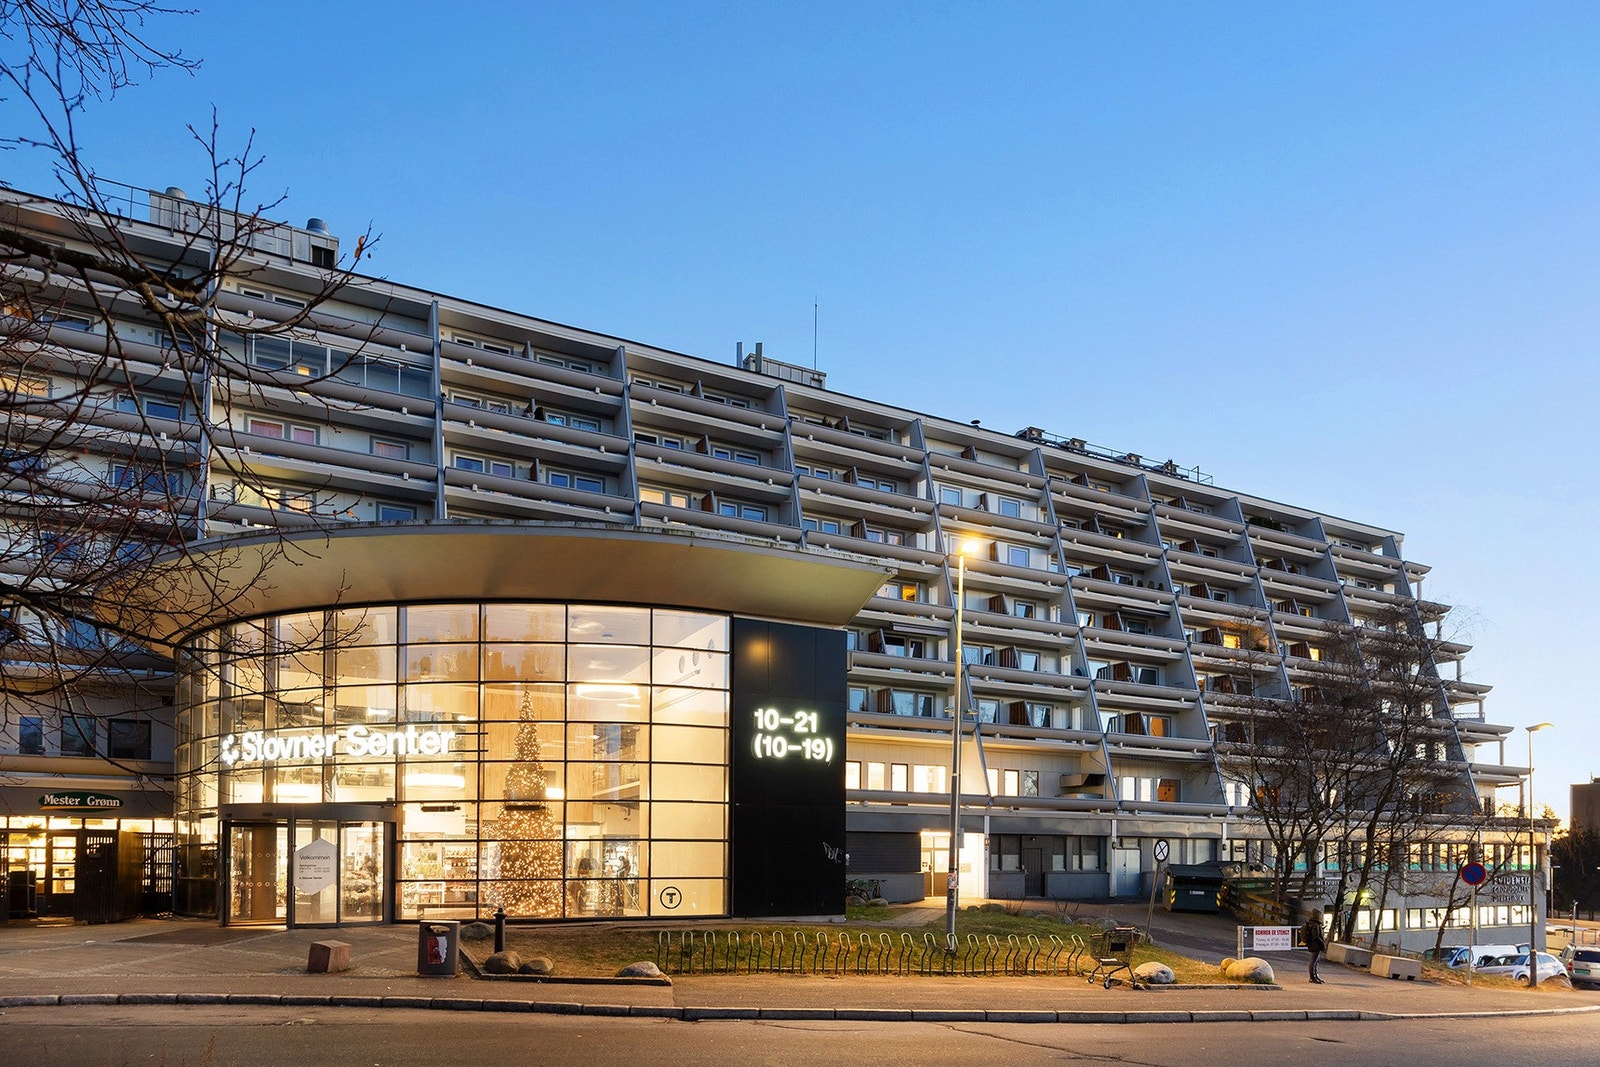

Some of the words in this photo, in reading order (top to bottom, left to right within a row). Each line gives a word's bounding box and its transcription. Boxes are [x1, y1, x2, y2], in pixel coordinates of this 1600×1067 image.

[754, 708, 817, 733] 10-21
[242, 731, 338, 762] Stovner
[345, 725, 456, 757] Senter
[754, 733, 833, 762] (10-19)
[44, 794, 80, 806] Mester
[86, 795, 120, 807] Grønn
